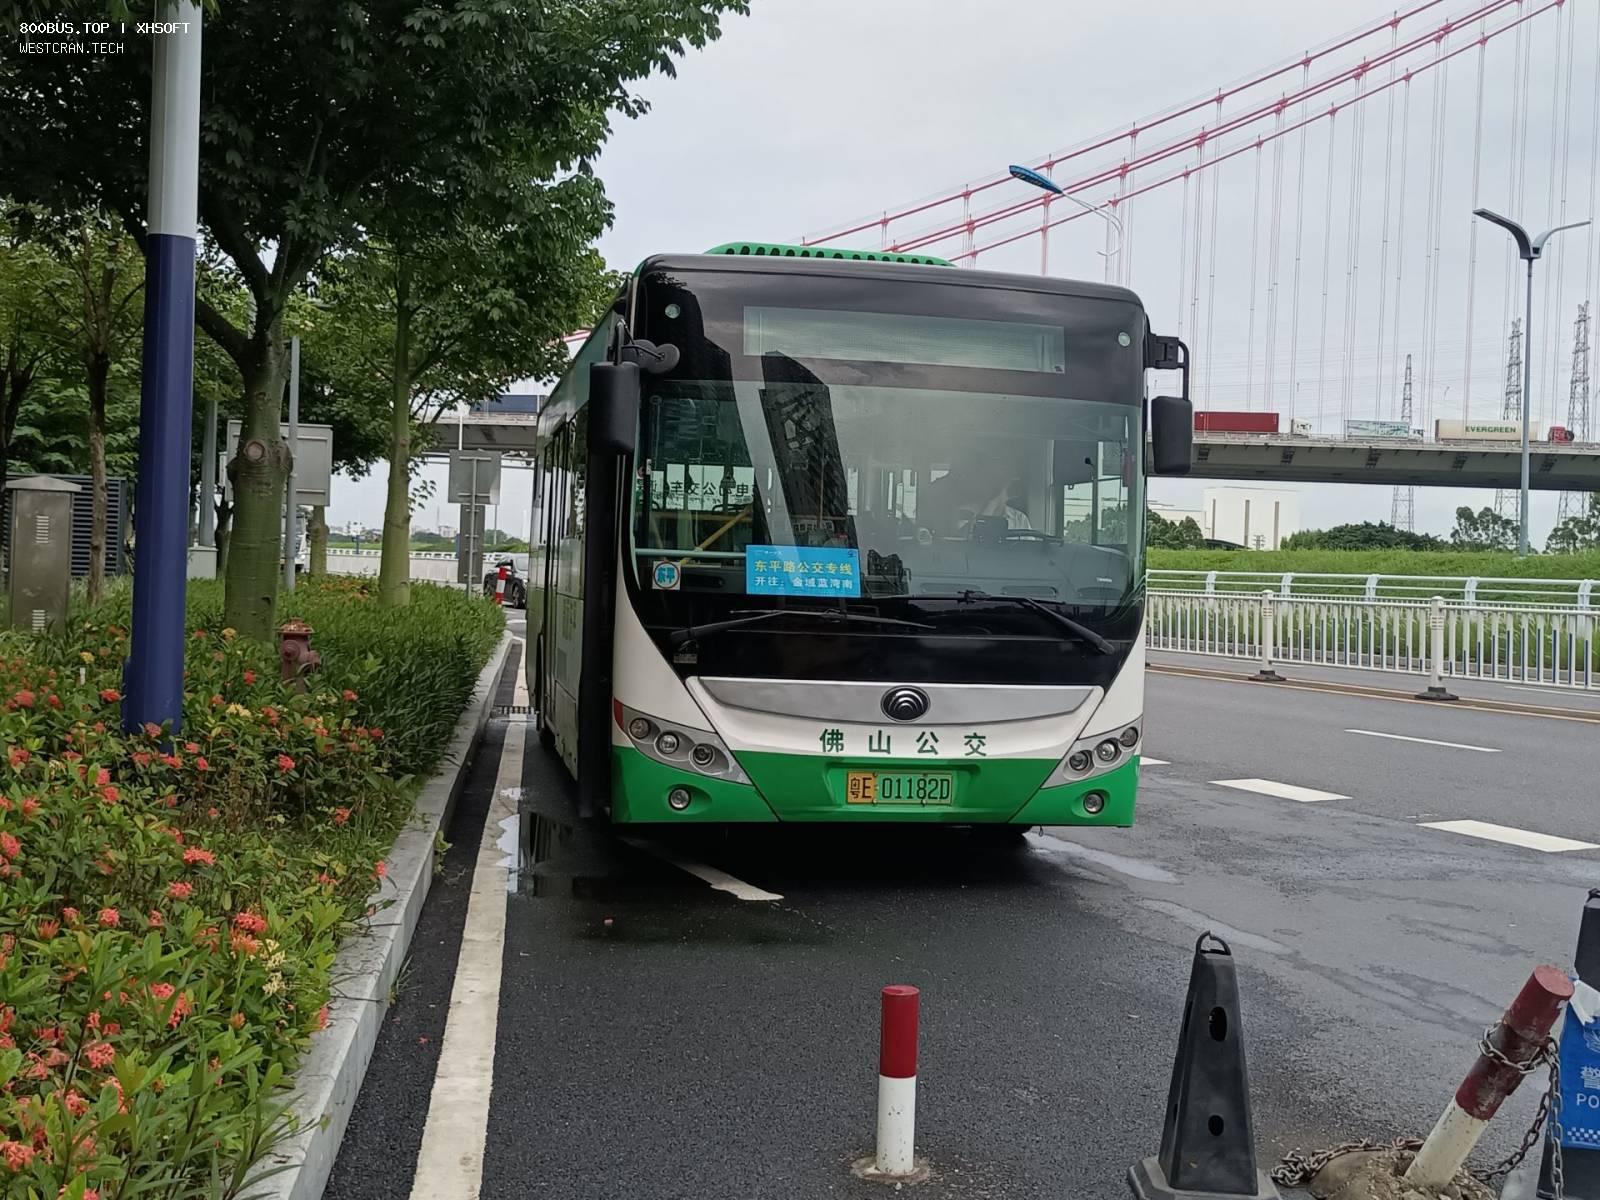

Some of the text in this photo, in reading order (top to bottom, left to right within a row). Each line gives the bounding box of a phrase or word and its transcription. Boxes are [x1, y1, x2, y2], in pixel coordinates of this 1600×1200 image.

[1465, 425, 1517, 434] EVERGREEN
[754, 559, 853, 576] 东平路公交专线
[819, 728, 988, 757] 佛山公交
[881, 777, 950, 801] 01182D
